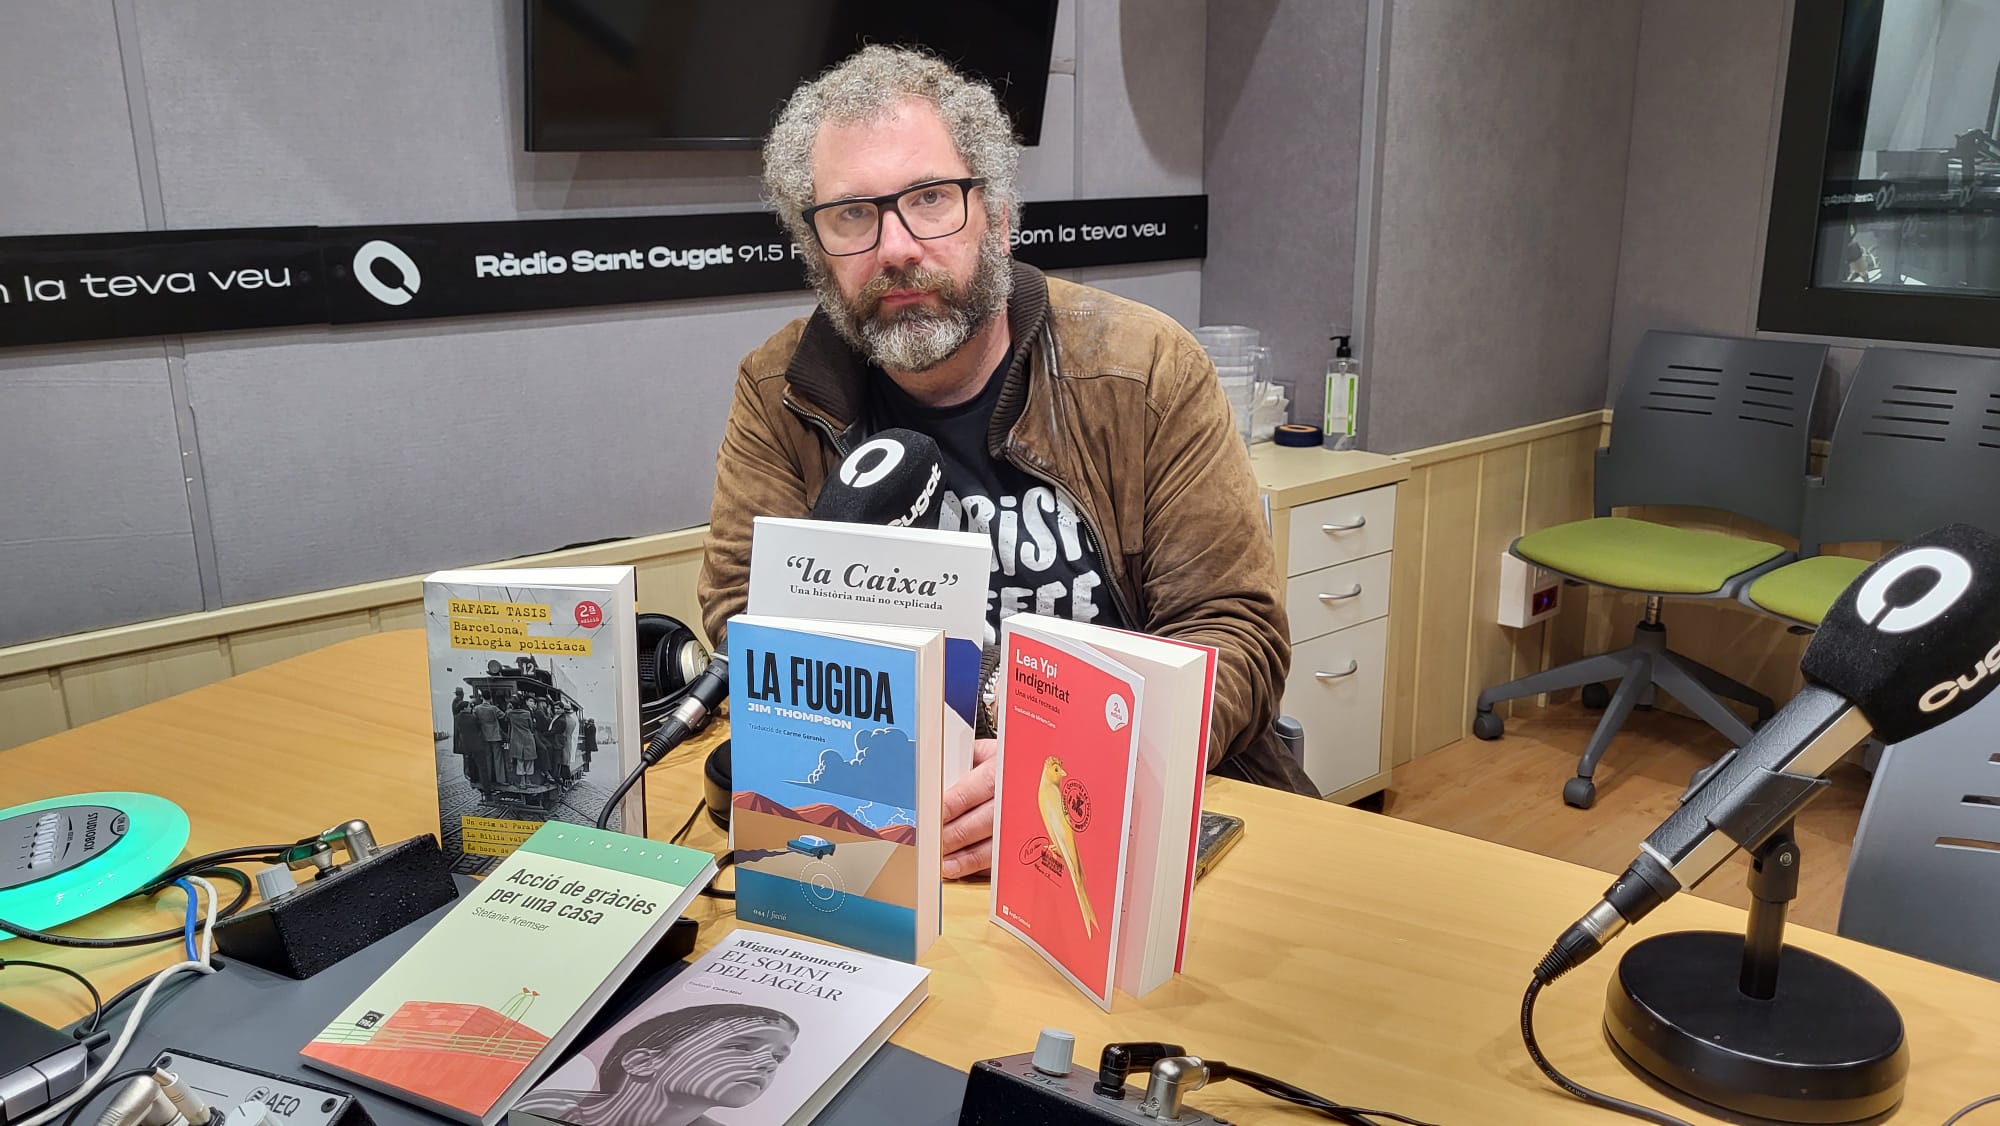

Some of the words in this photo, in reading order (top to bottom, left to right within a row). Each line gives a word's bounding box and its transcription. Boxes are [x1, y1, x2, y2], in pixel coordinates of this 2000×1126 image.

[1009, 228, 1053, 246] som
[1058, 224, 1076, 242] la
[1080, 223, 1127, 241] teva
[1131, 222, 1166, 237] veu
[475, 252, 567, 278] Ràdio
[571, 248, 644, 273] Sant
[648, 244, 733, 271] Cugat
[738, 244, 784, 263] 91.5
[791, 243, 803, 260] F
[24, 275, 66, 302] la
[80, 272, 196, 299] teva
[208, 267, 292, 291] veu
[452, 602, 499, 616] RAFAEL
[506, 606, 547, 618] TASIS
[790, 584, 811, 595] Una
[813, 585, 853, 601] història
[855, 593, 876, 603] mai
[877, 597, 891, 605] no
[893, 596, 943, 611] explicada
[454, 621, 523, 636] Barcelona,
[454, 636, 512, 650] trilogia
[519, 639, 586, 652] policíaca
[522, 662, 535, 675] 12
[1016, 648, 1038, 670] Lea
[1040, 657, 1058, 679] Ypi
[746, 648, 782, 703] LA
[790, 655, 895, 725] FUGIDA
[1015, 667, 1070, 704] Indignitat
[747, 702, 771, 714] JIM
[774, 706, 852, 730] THOMPSON
[83, 812, 99, 852] STUDIOBOX
[484, 887, 522, 904] per
[520, 895, 558, 914] una
[558, 903, 605, 926] casa
[506, 868, 564, 891] Acció
[559, 879, 587, 897] de
[582, 885, 657, 916] gràcies
[471, 906, 511, 923] Stefanie
[510, 914, 550, 932] Kremser
[718, 950, 749, 965] EL
[750, 956, 833, 982] SOMNI
[734, 939, 789, 956] Miguel
[788, 950, 863, 975] Bonnefoy
[704, 962, 750, 980] DEL
[750, 973, 844, 1002] JAGUAR
[265, 1093, 301, 1117] AEQ
